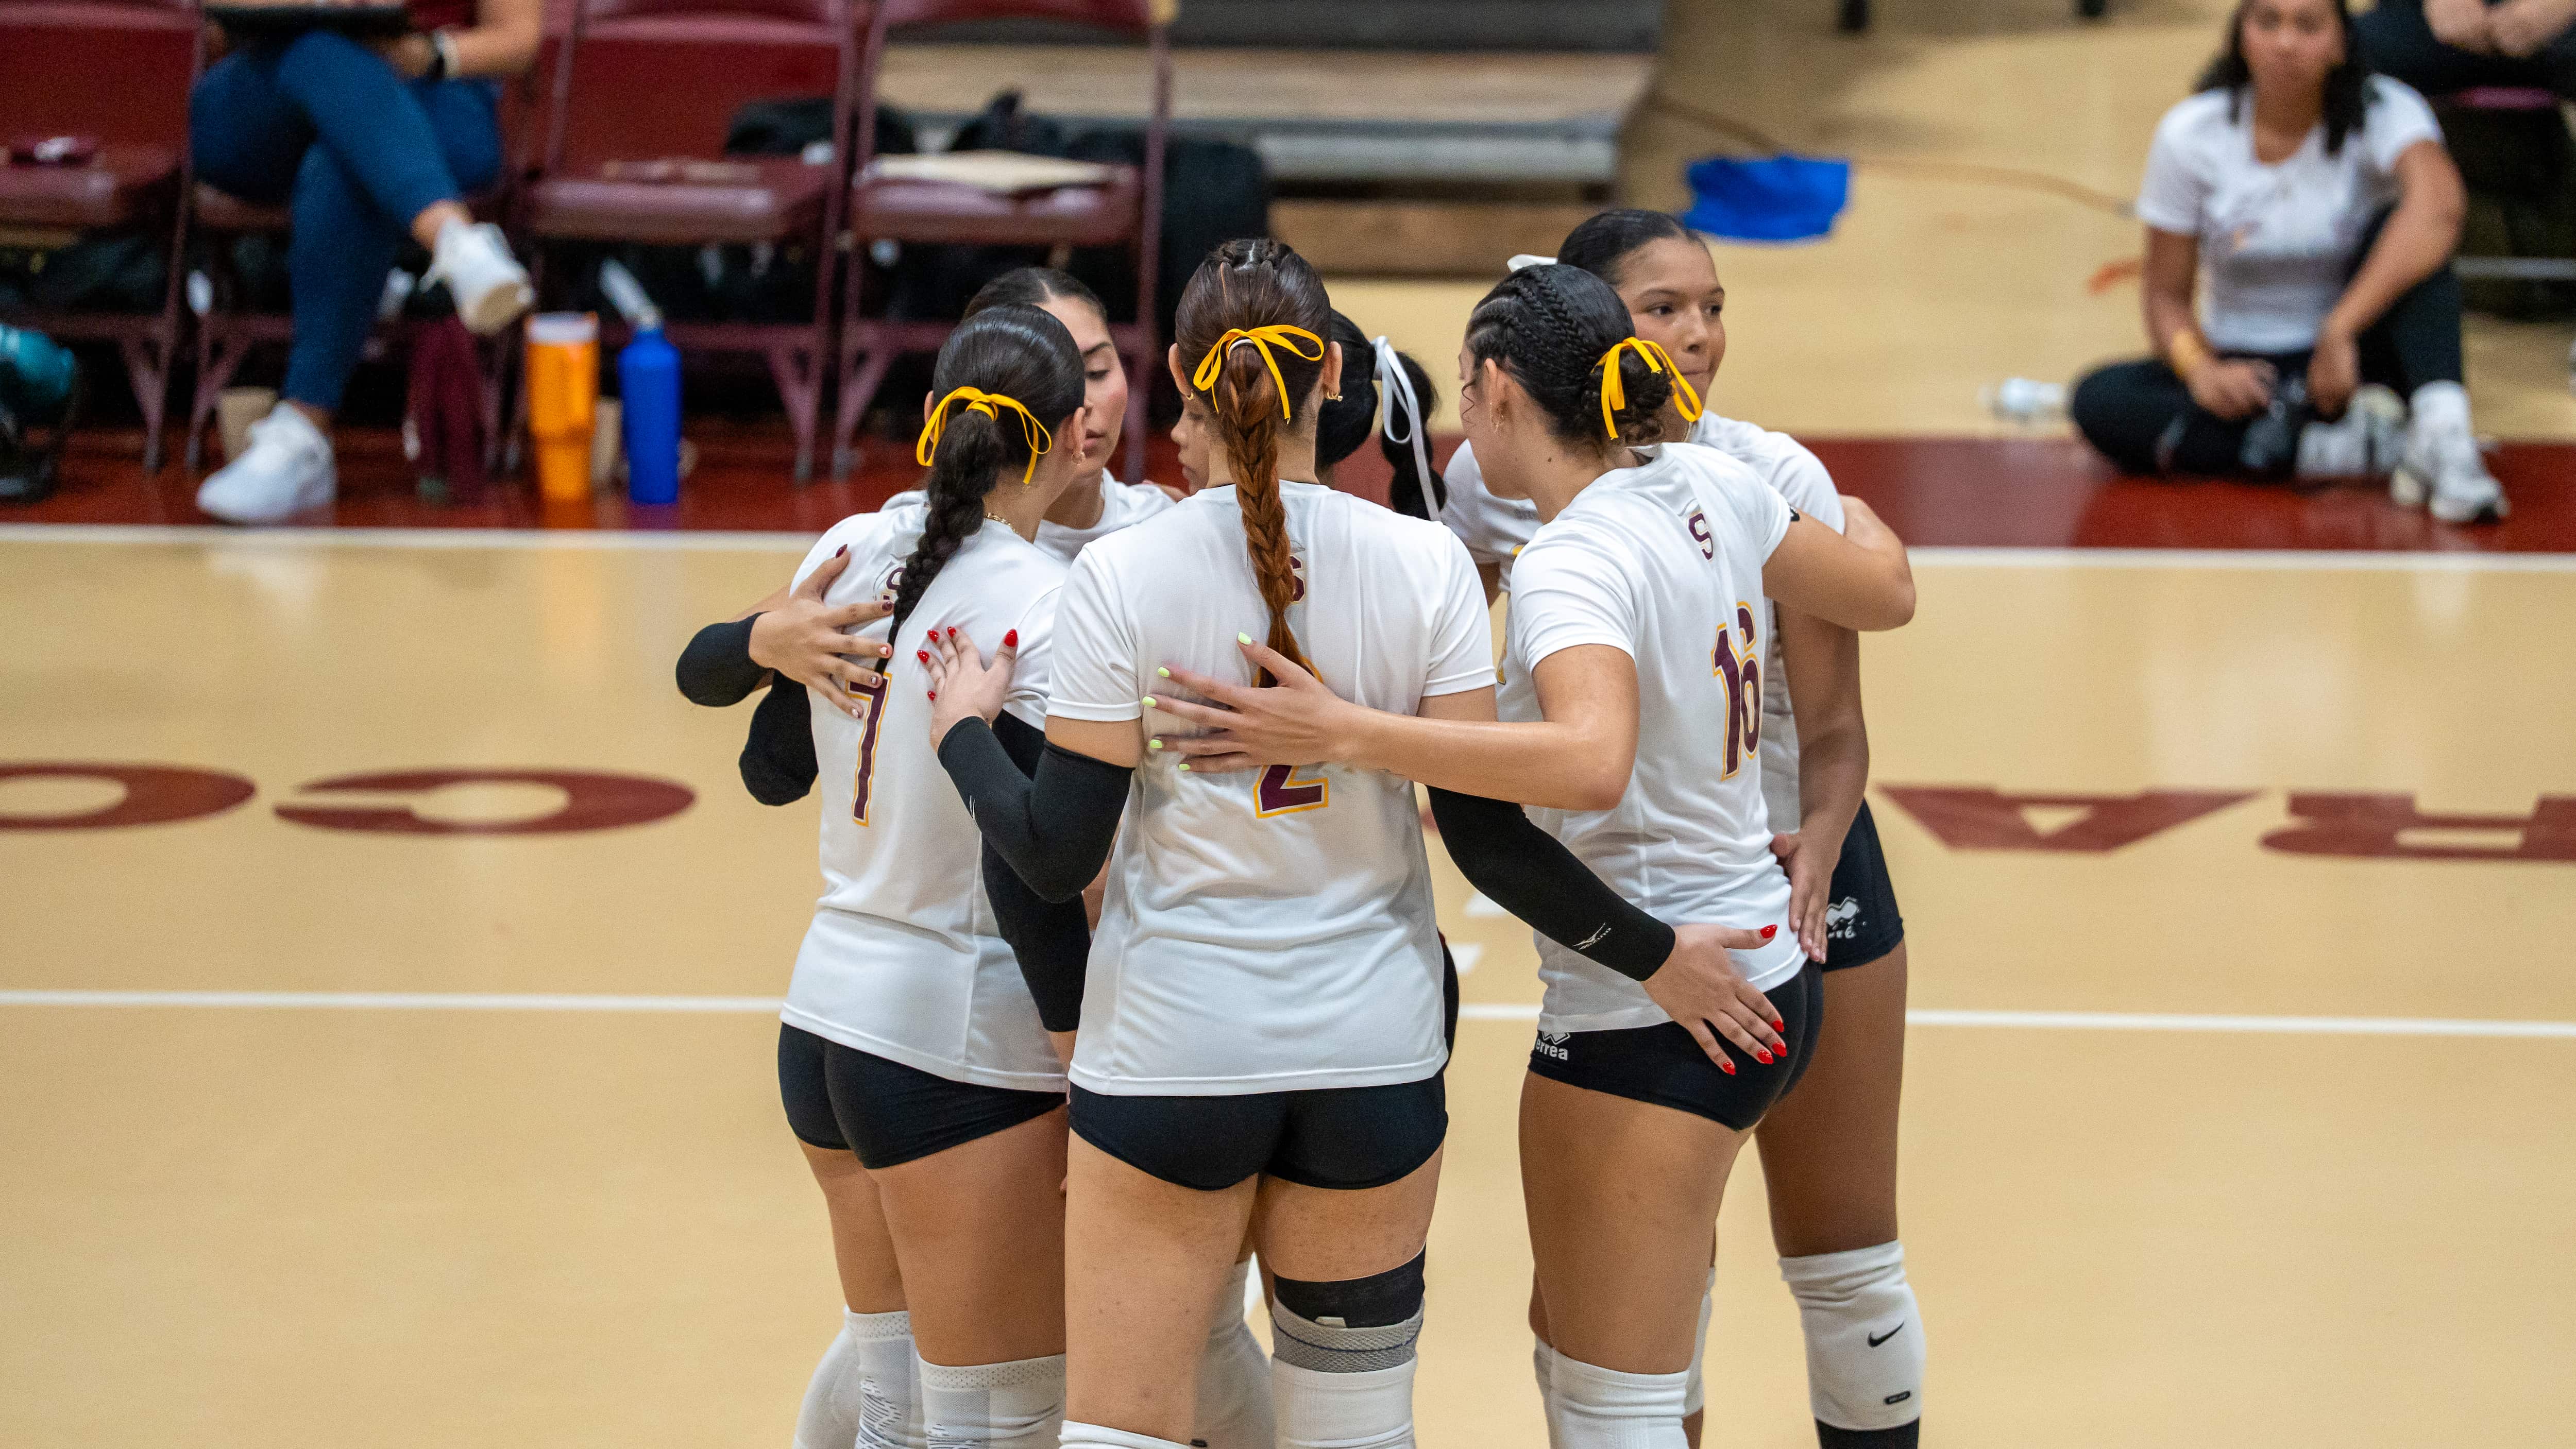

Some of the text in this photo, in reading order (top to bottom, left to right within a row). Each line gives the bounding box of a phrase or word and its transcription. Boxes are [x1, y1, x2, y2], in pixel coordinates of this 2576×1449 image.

[1688, 511, 1714, 561] S
[845, 672, 893, 827] 7
[1710, 601, 1762, 782] 16
